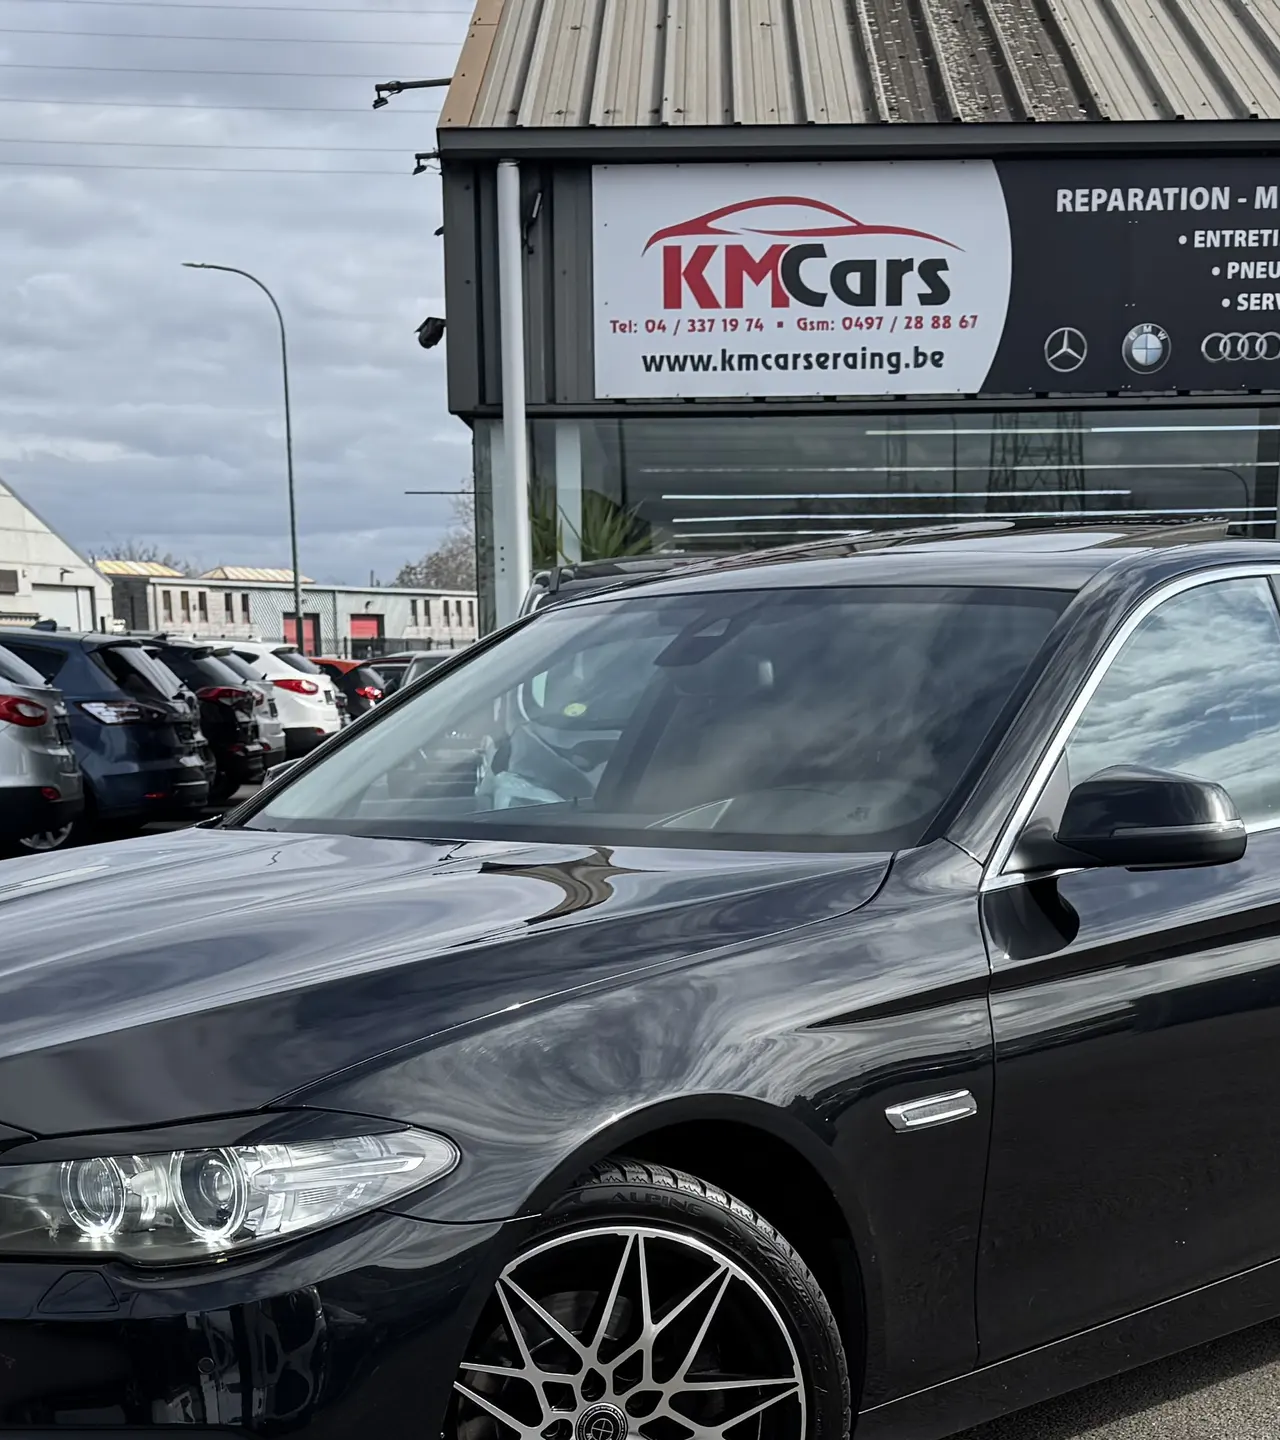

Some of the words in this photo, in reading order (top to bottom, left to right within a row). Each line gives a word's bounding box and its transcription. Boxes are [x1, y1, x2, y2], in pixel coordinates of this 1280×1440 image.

[1056, 185, 1231, 213] REPARATION
[662, 243, 952, 310] KMCars
[609, 319, 638, 334] Tel:
[644, 319, 667, 334] 04
[687, 318, 715, 333] 337
[721, 318, 739, 332] 19
[745, 318, 765, 333] 74
[796, 317, 836, 332] Gsm:
[841, 316, 884, 331] 0497
[904, 316, 924, 330] 28
[931, 315, 952, 329] 88
[958, 314, 979, 329] 67
[641, 346, 945, 375] www.kmcarseraing.be
